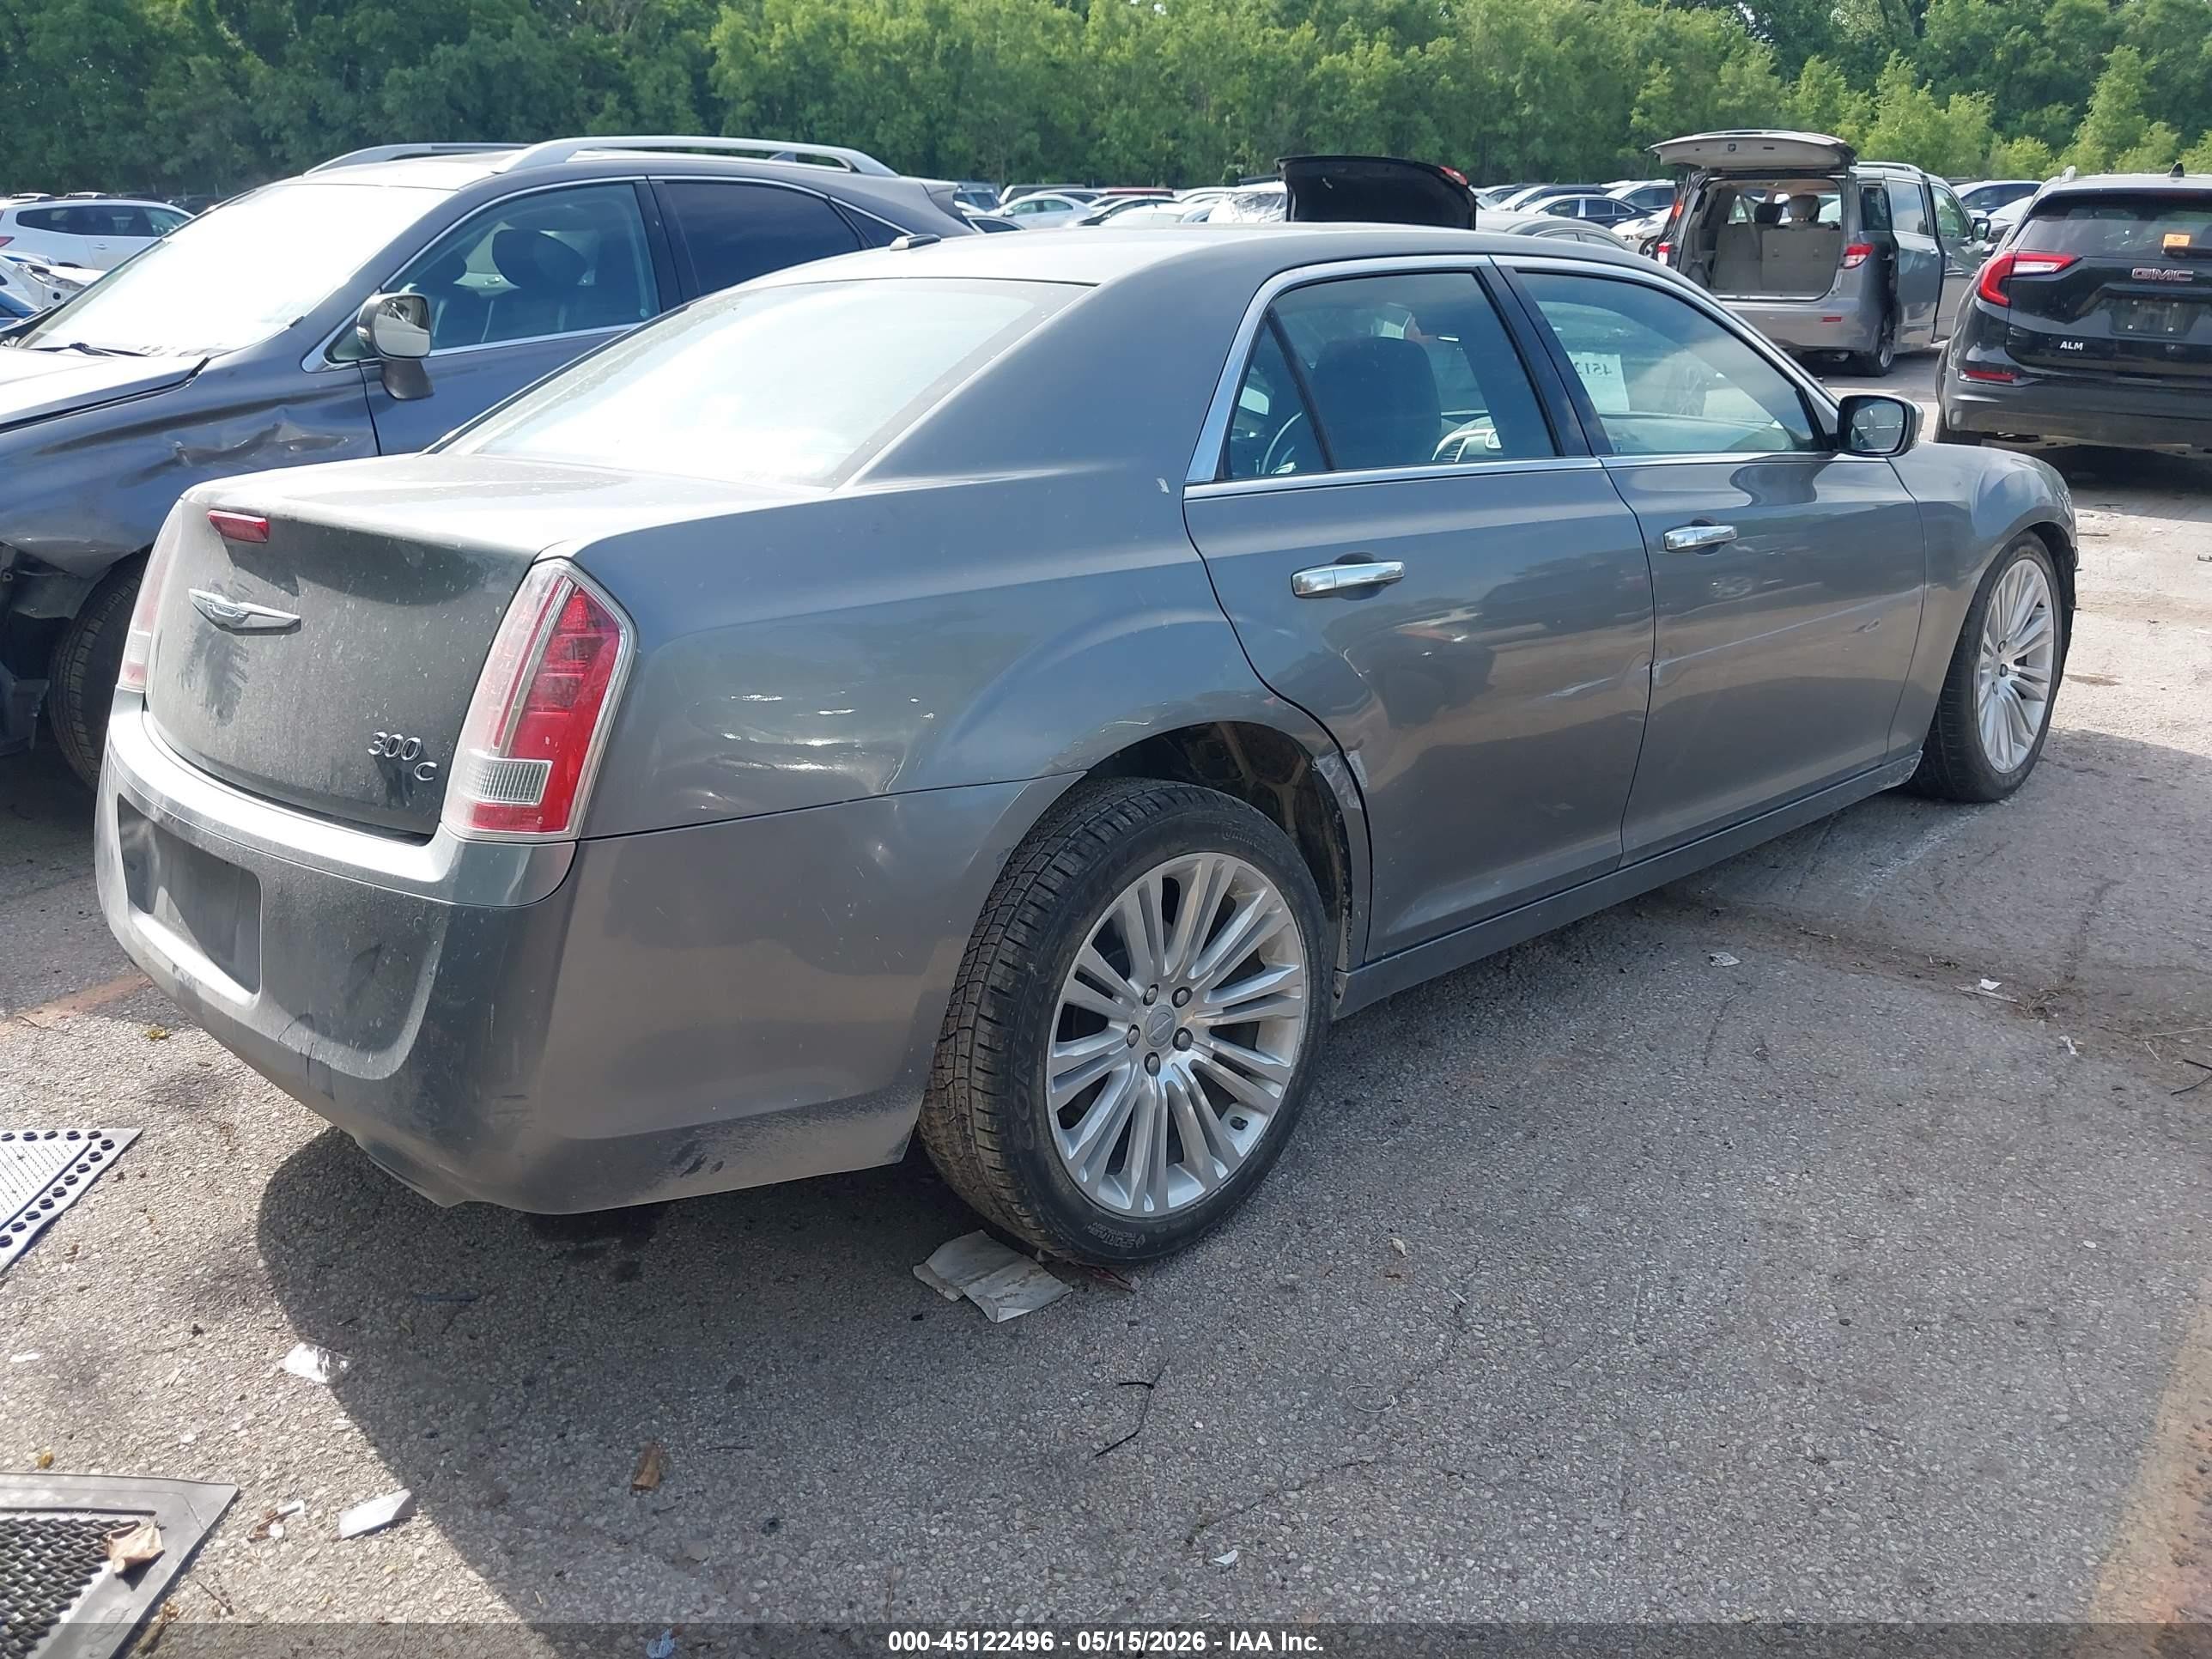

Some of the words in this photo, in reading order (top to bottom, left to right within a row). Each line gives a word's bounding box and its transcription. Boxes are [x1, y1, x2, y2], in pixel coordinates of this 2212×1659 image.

[2131, 267, 2194, 282] GMC
[2059, 340, 2084, 351] ALM
[368, 731, 422, 761] 300
[414, 761, 438, 781] C
